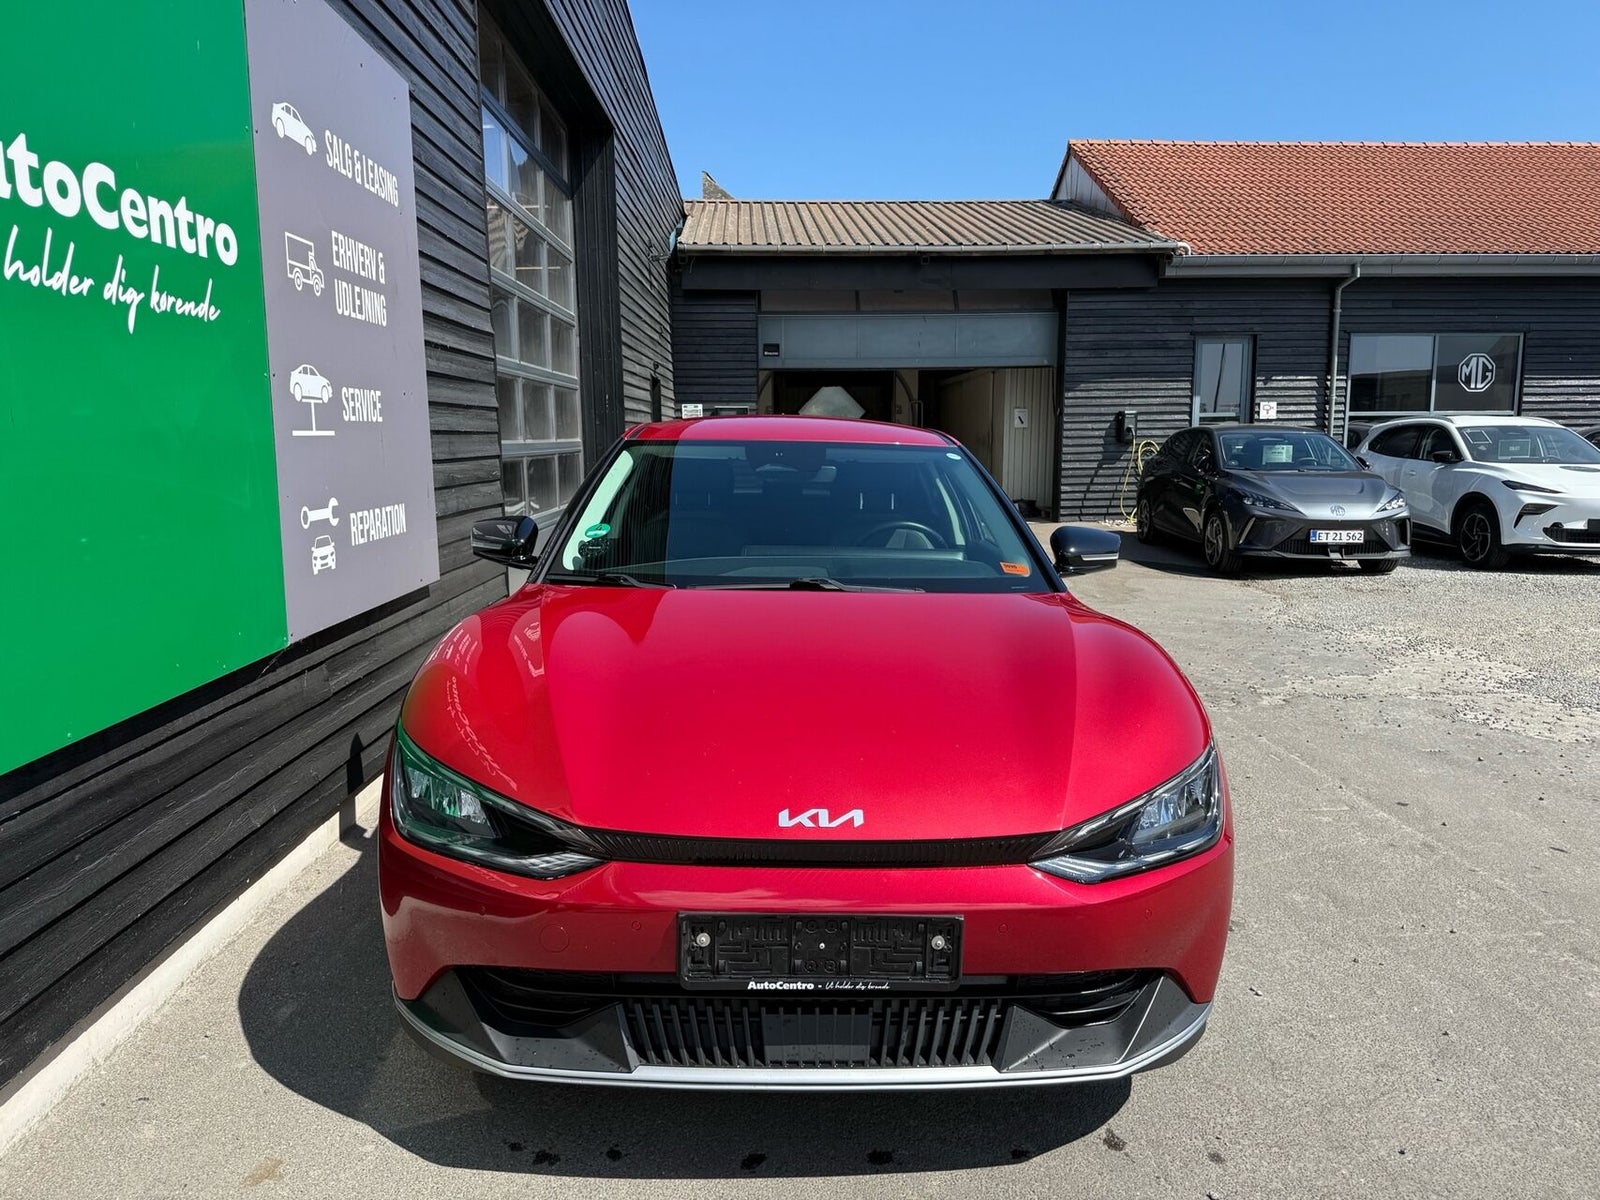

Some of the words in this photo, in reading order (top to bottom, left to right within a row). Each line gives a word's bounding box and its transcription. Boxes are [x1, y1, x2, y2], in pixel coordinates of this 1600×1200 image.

[325, 129, 353, 179] SALG
[353, 149, 362, 185] &
[362, 154, 399, 207] LEASING
[331, 230, 376, 281] ERHVERV
[378, 251, 386, 285] &
[3, 224, 95, 297] holder
[103, 254, 145, 335] dig
[334, 278, 387, 327] UDLEJNING
[1460, 356, 1493, 389] MG
[341, 386, 383, 423] SERVICE
[350, 503, 407, 546] REPARATION
[1317, 532, 1331, 541] ET
[1332, 532, 1343, 541] 21
[1345, 532, 1363, 541] 562
[778, 808, 864, 828] KIA
[747, 981, 815, 990] AutoCentro
